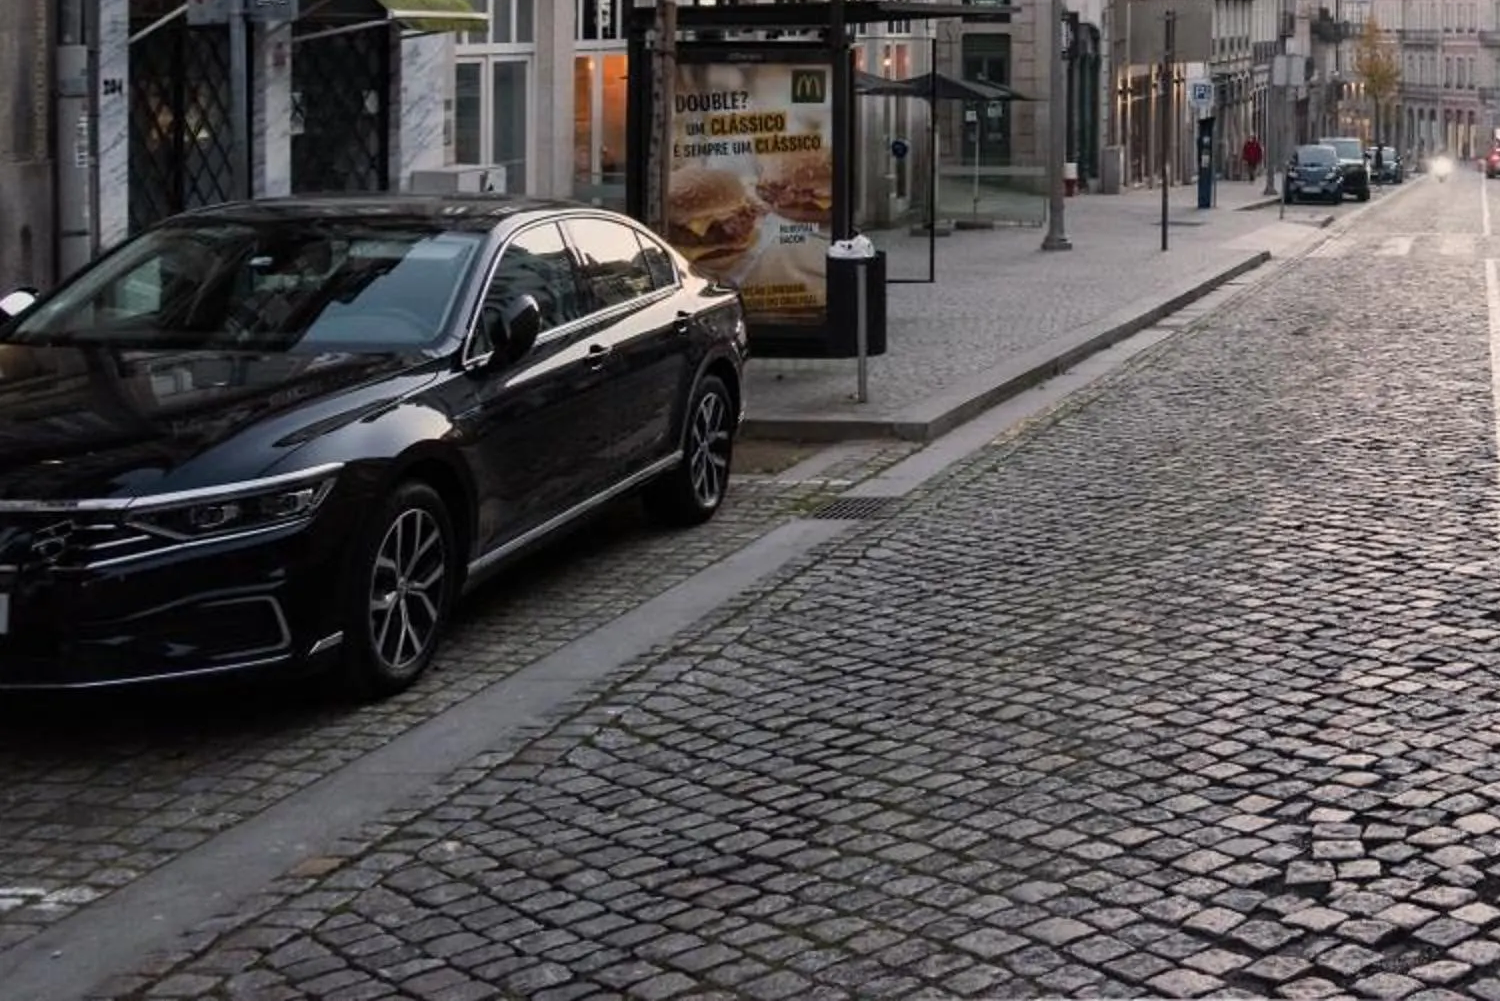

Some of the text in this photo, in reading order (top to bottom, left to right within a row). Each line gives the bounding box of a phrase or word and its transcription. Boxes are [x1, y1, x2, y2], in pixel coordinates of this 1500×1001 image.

[675, 90, 749, 113] DOUBLE?
[686, 113, 785, 136] UM CLÁSSICO
[683, 142, 728, 157] SEMPRE
[731, 142, 752, 154] UM
[755, 134, 821, 153] CLÁSSICO
